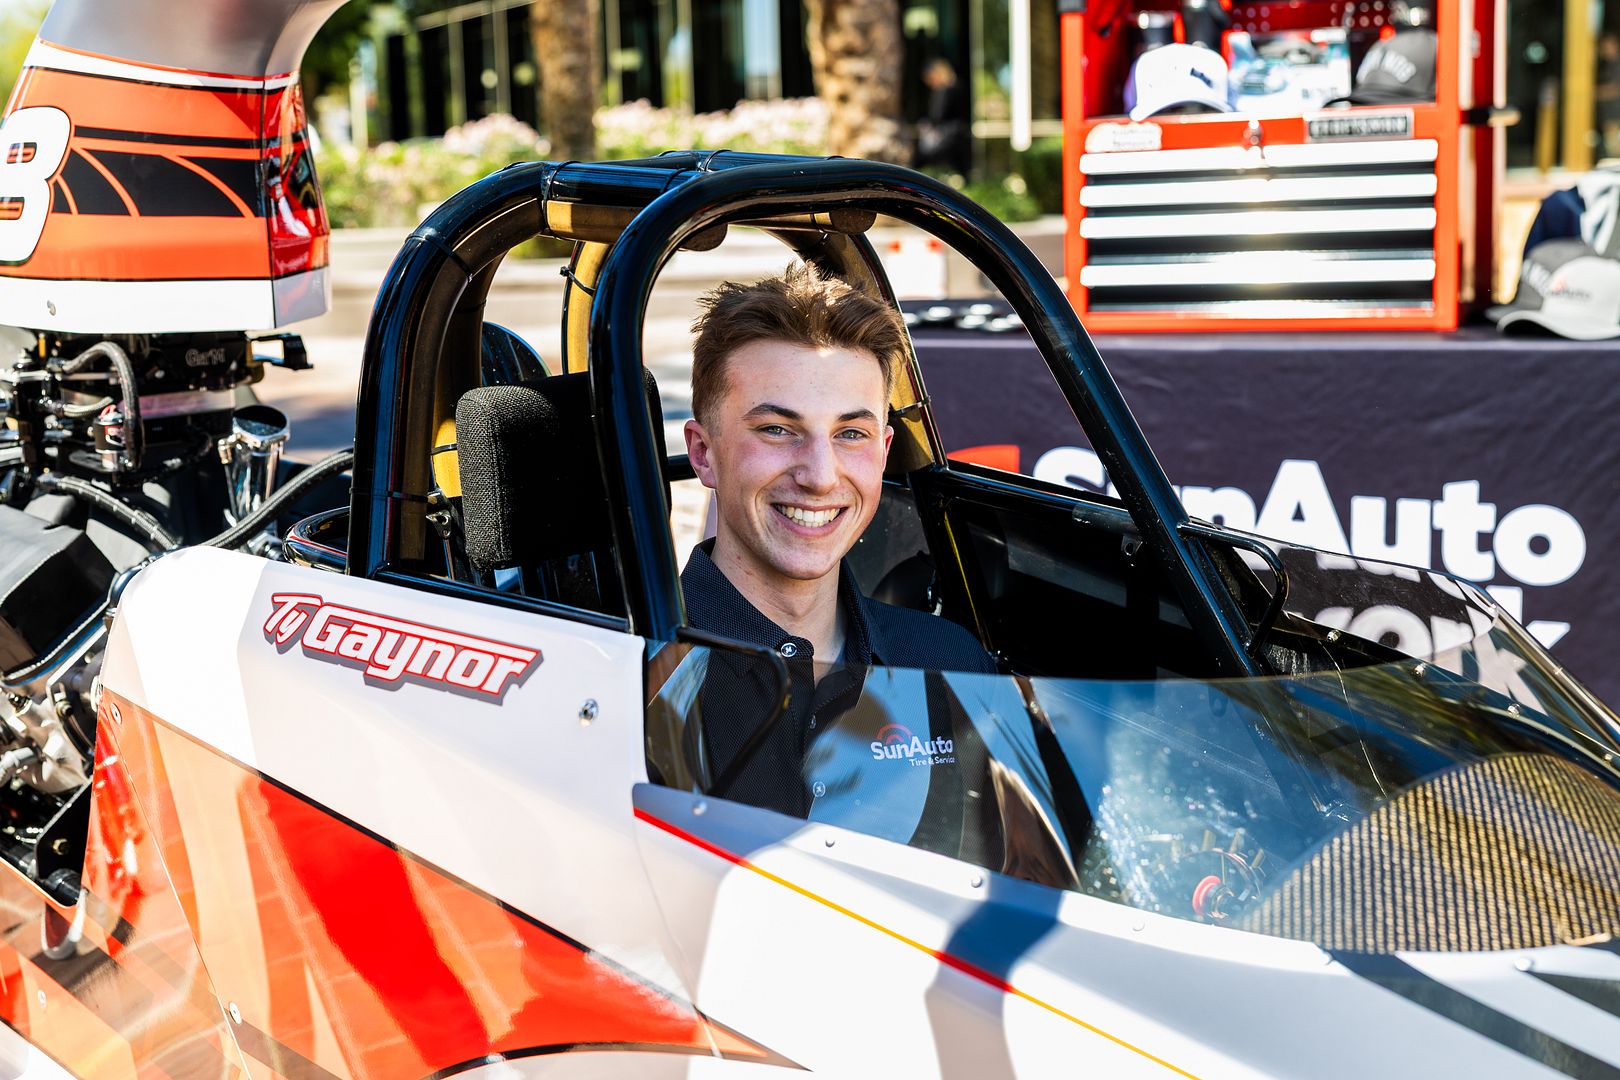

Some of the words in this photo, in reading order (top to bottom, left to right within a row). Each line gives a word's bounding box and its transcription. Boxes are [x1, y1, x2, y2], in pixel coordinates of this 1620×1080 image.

[263, 592, 322, 649] Ty
[302, 602, 542, 699] Gaynor
[870, 736, 953, 760] SunAuto
[908, 758, 927, 767] Tire
[928, 757, 935, 765] &
